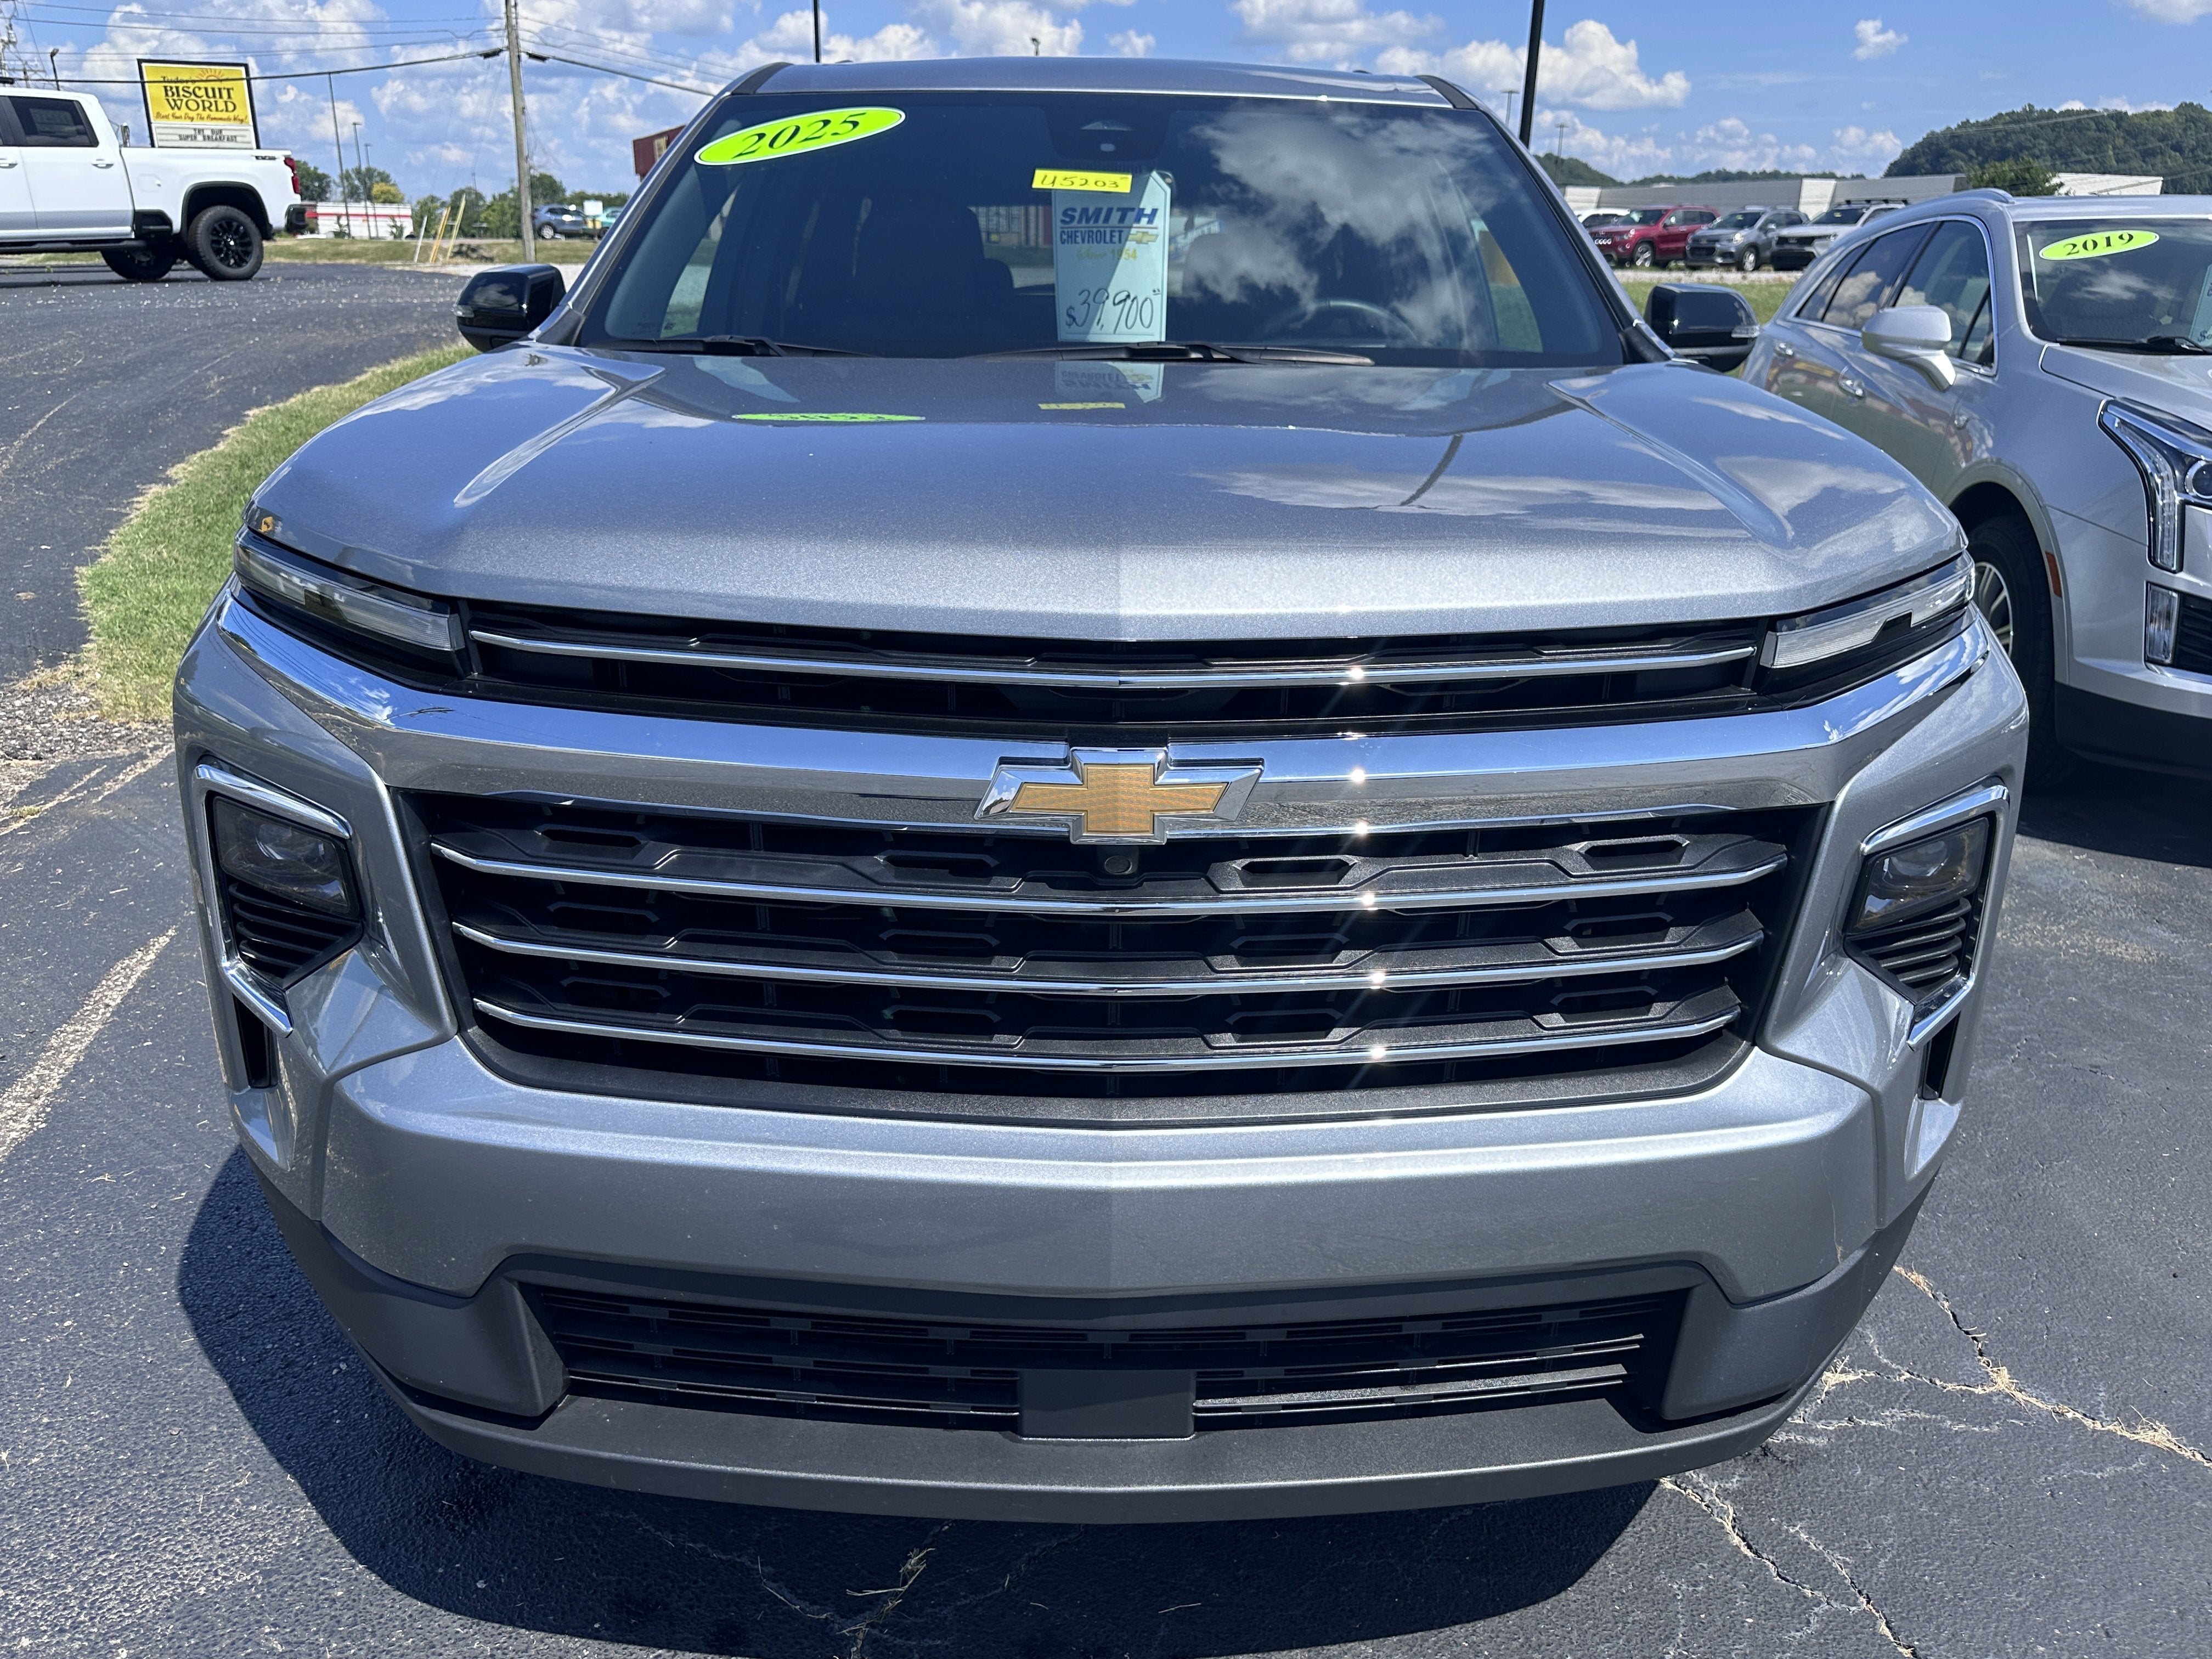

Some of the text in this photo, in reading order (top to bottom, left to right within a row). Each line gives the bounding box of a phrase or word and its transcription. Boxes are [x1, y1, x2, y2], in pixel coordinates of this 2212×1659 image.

[163, 85, 234, 99] BISCUIT
[165, 98, 236, 113] WORLD
[731, 112, 867, 160] 2025
[1060, 207, 1159, 225] SMITH
[1059, 230, 1124, 245] CHEVROLET
[2063, 232, 2134, 256] 2019
[1111, 248, 1137, 261] 1954
